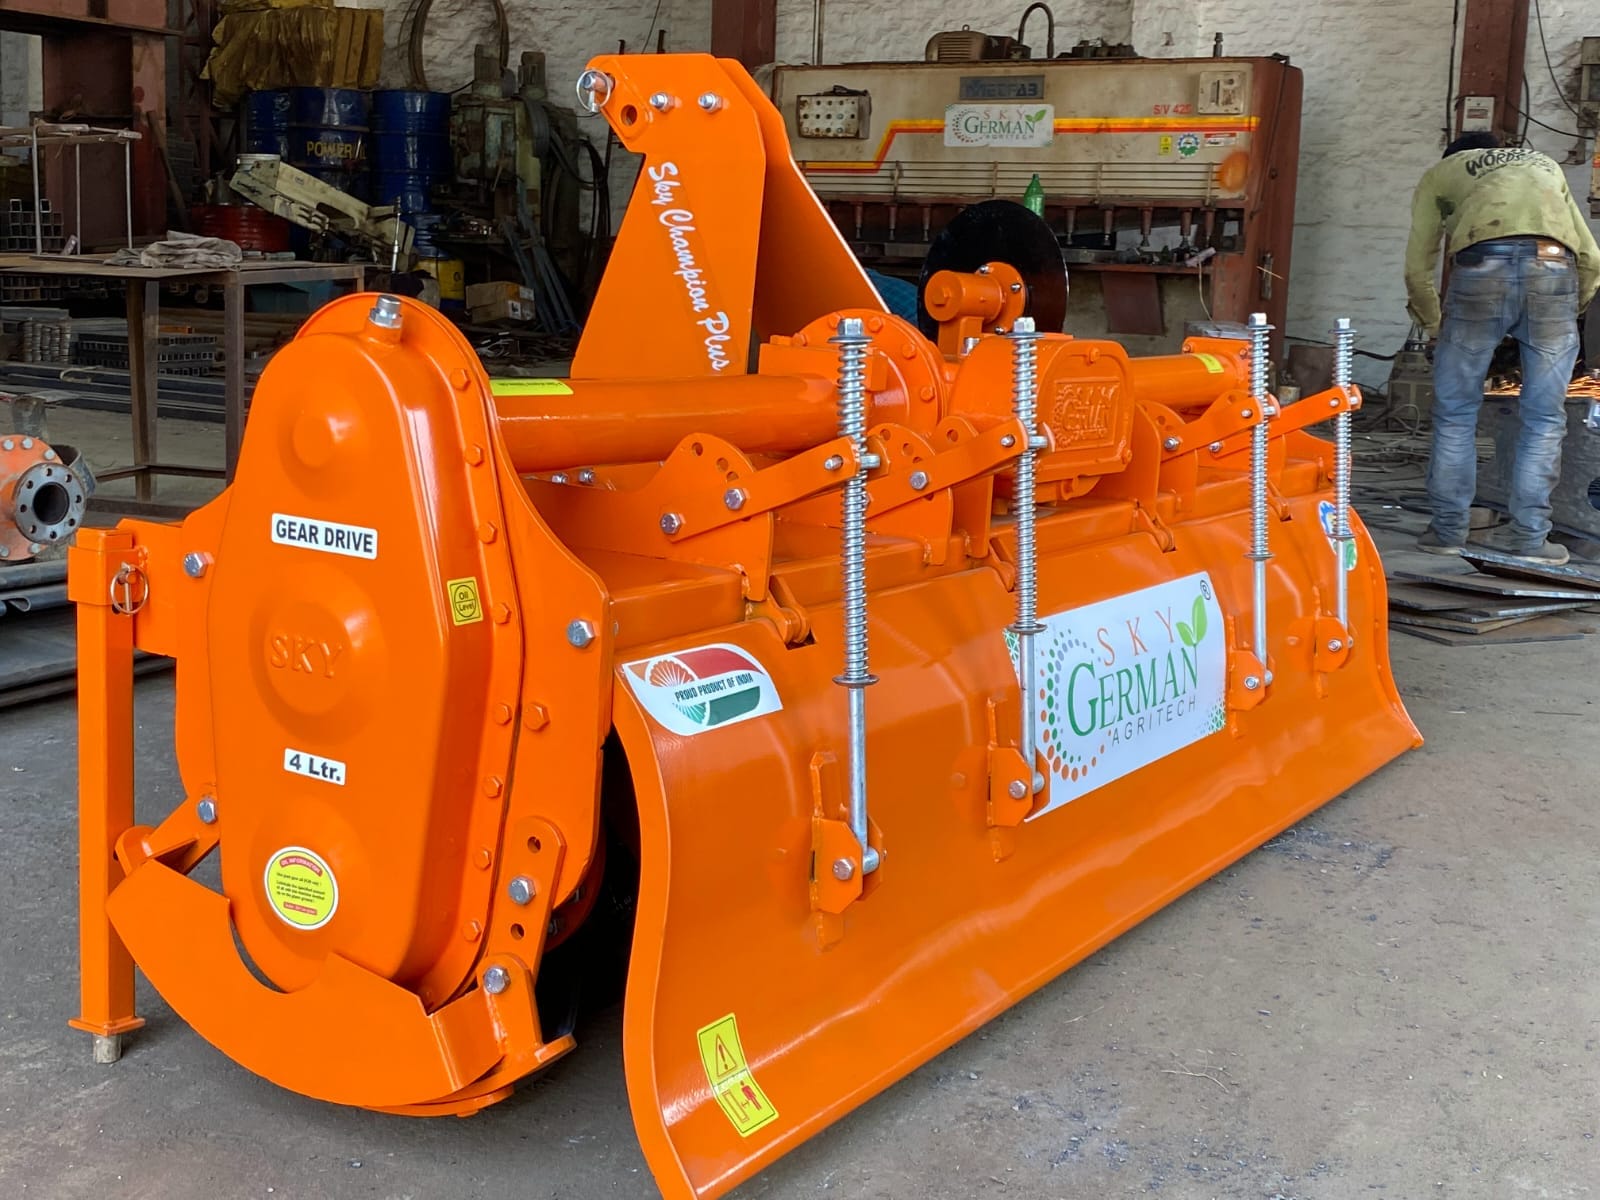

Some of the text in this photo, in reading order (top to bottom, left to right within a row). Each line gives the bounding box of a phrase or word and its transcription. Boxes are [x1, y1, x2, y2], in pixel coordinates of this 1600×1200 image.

[964, 115, 1036, 134] GERMAN
[984, 109, 1026, 120] SKY
[648, 161, 732, 371] Sky Champion Plus
[276, 519, 374, 554] GEAR DRIVE
[1096, 606, 1175, 667] SKY
[270, 634, 344, 680] SKY
[675, 672, 754, 702] PROUD PRODUCT OF INDIA
[1067, 643, 1198, 737] GERMAN
[1111, 694, 1197, 747] AGRITECH
[289, 753, 342, 781] 4 Ltr.
